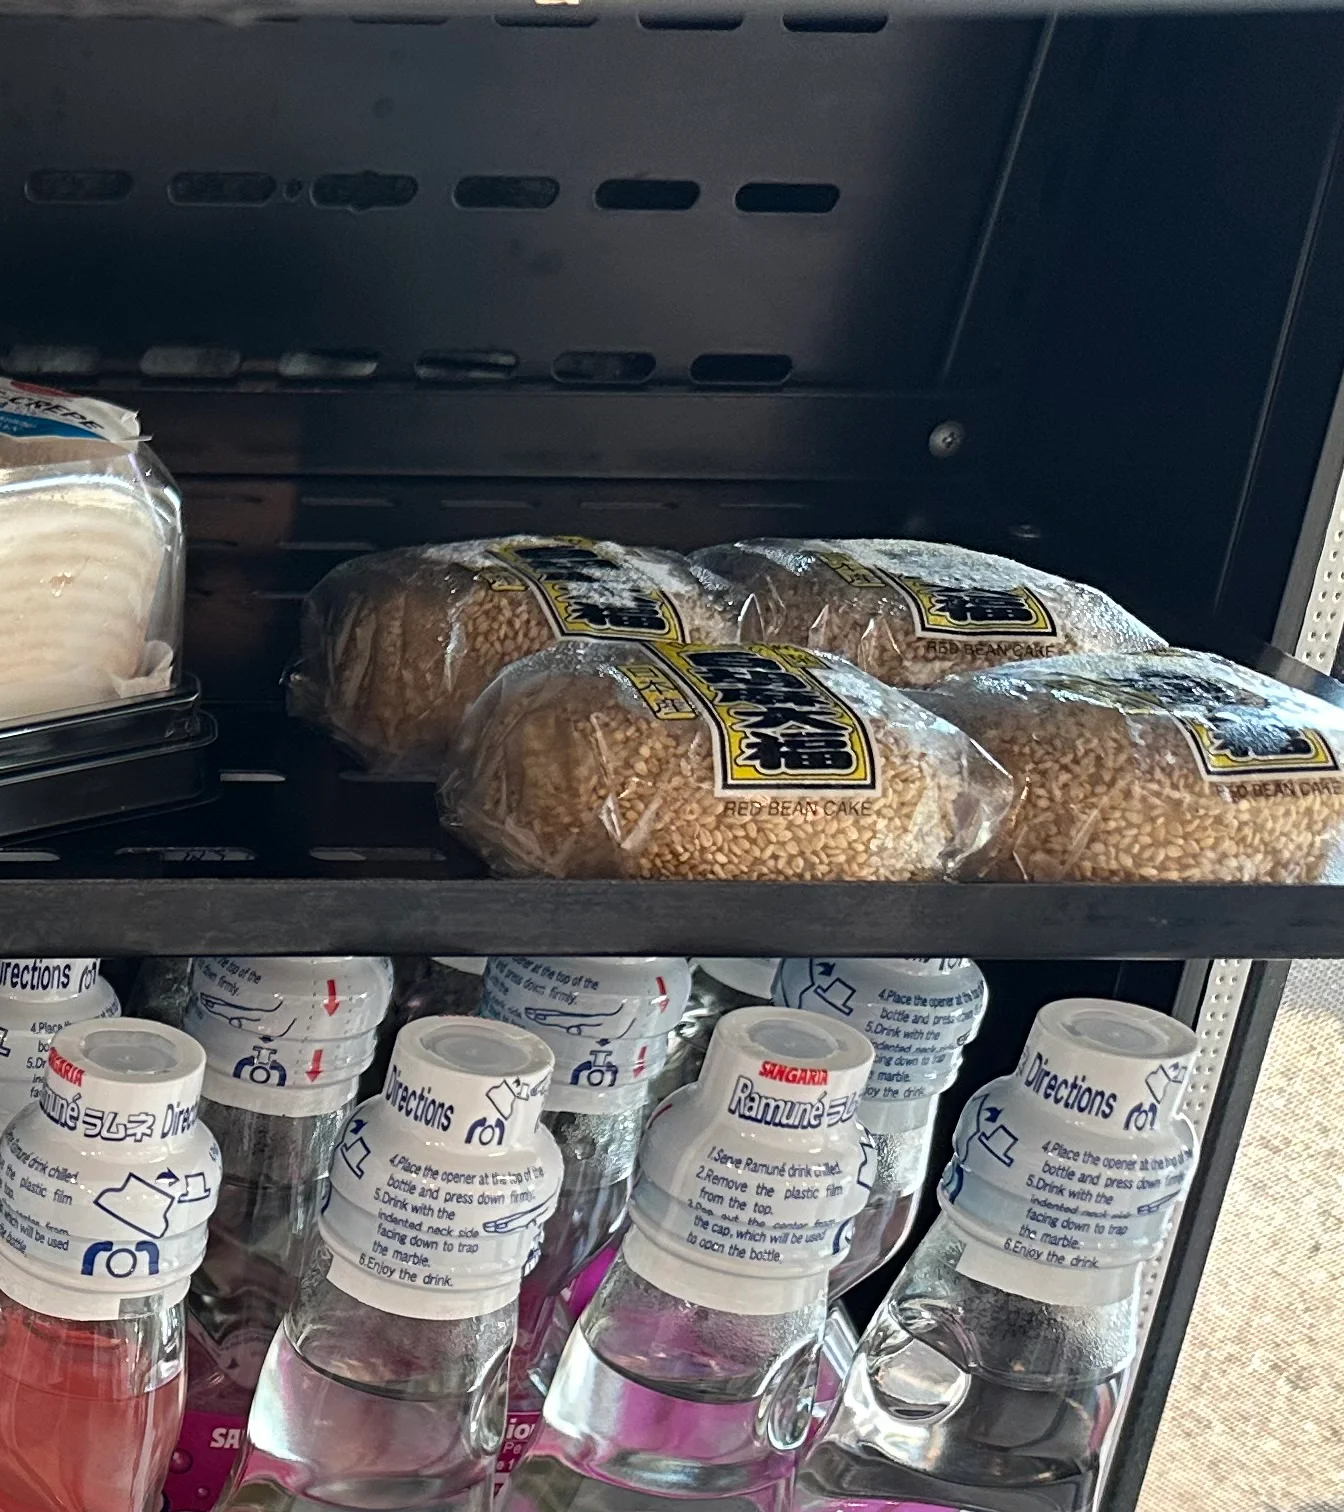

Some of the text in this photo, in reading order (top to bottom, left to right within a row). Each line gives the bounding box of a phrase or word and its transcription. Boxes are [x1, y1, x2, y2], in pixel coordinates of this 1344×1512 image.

[926, 640, 1054, 658] RED BEAN CAKE
[1254, 780, 1344, 797] BEAN CAKE
[724, 800, 872, 817] RED BEAN CAKE
[758, 1059, 829, 1086] SANGARIA
[1023, 1050, 1117, 1121] Directions
[384, 1064, 455, 1132] Directions
[728, 1074, 826, 1129] Ramuné
[82, 1109, 156, 1143] ラムネ
[389, 1153, 422, 1176] 4.Place
[422, 1165, 439, 1179] the
[441, 1172, 475, 1185] opener
[479, 1174, 490, 1185] at
[707, 1146, 812, 1178] 1.Serve Ramuné drink
[387, 1173, 505, 1205] bottle and press down
[695, 1165, 843, 1201] 2.Remove the plastic film
[373, 1187, 455, 1220] 5.Drink with the
[699, 1187, 724, 1205] from
[728, 1196, 747, 1211] the
[753, 1202, 774, 1215] top.
[377, 1208, 423, 1232] indented
[693, 1215, 826, 1244] the cap, which will be used
[377, 1223, 479, 1253] facing down to trap
[686, 1231, 697, 1244] to
[699, 1236, 724, 1252] open
[728, 1244, 746, 1258] the
[372, 1240, 431, 1268] the marble.
[359, 1253, 454, 1287] 6.Enjoy the drink.
